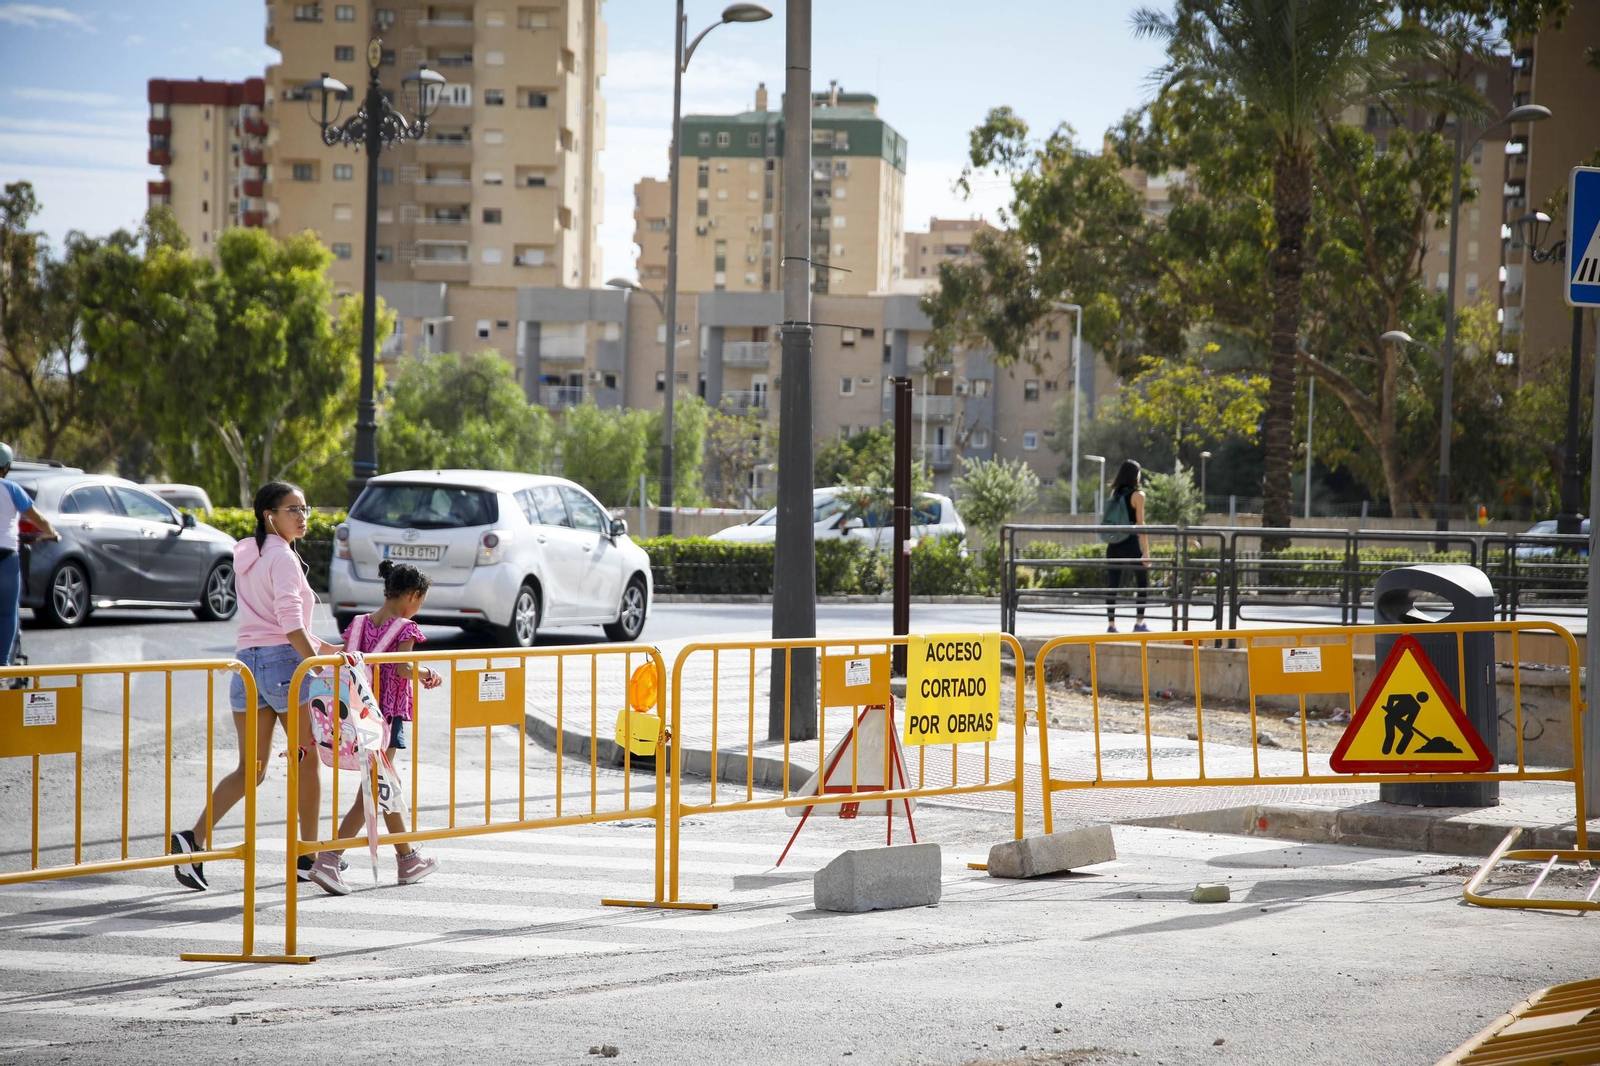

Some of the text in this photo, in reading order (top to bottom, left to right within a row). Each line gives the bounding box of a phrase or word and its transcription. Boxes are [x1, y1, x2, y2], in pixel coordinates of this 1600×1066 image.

[391, 545, 436, 558] 4419 GTH
[926, 642, 982, 662] ACCESO
[921, 677, 987, 698] CORTADO
[909, 712, 993, 735] POR OBRAS
